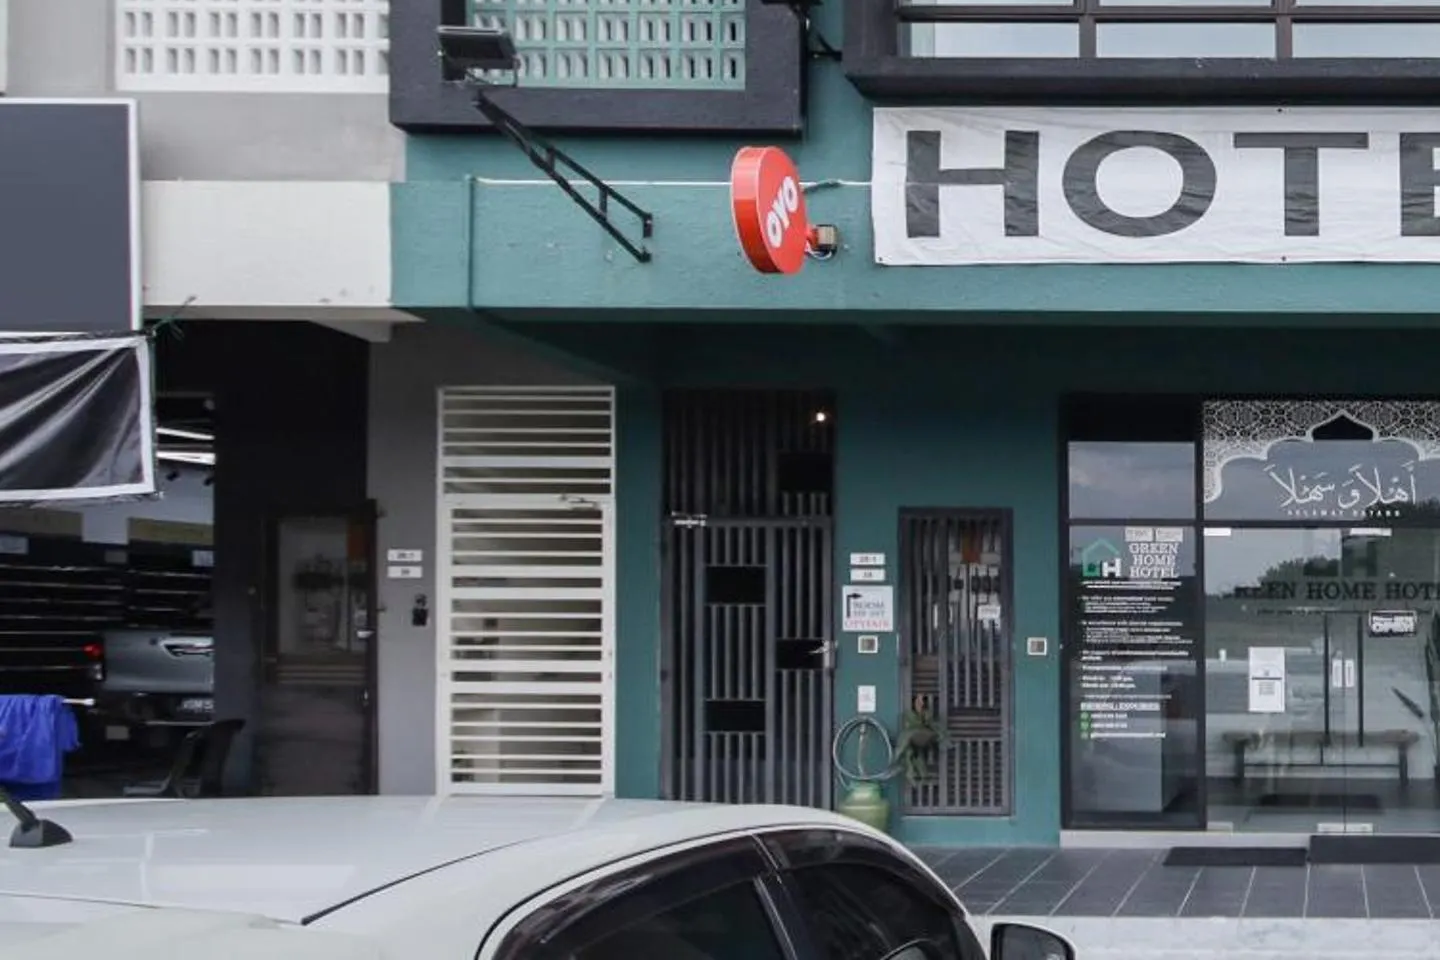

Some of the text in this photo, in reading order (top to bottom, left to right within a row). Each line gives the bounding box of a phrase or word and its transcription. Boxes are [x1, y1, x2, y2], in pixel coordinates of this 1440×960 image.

[766, 175, 798, 249] OYO
[1128, 542, 1179, 554] GREEN
[1132, 554, 1176, 566] HOME
[1129, 566, 1179, 578] HOTEL
[1306, 581, 1375, 601] HOME
